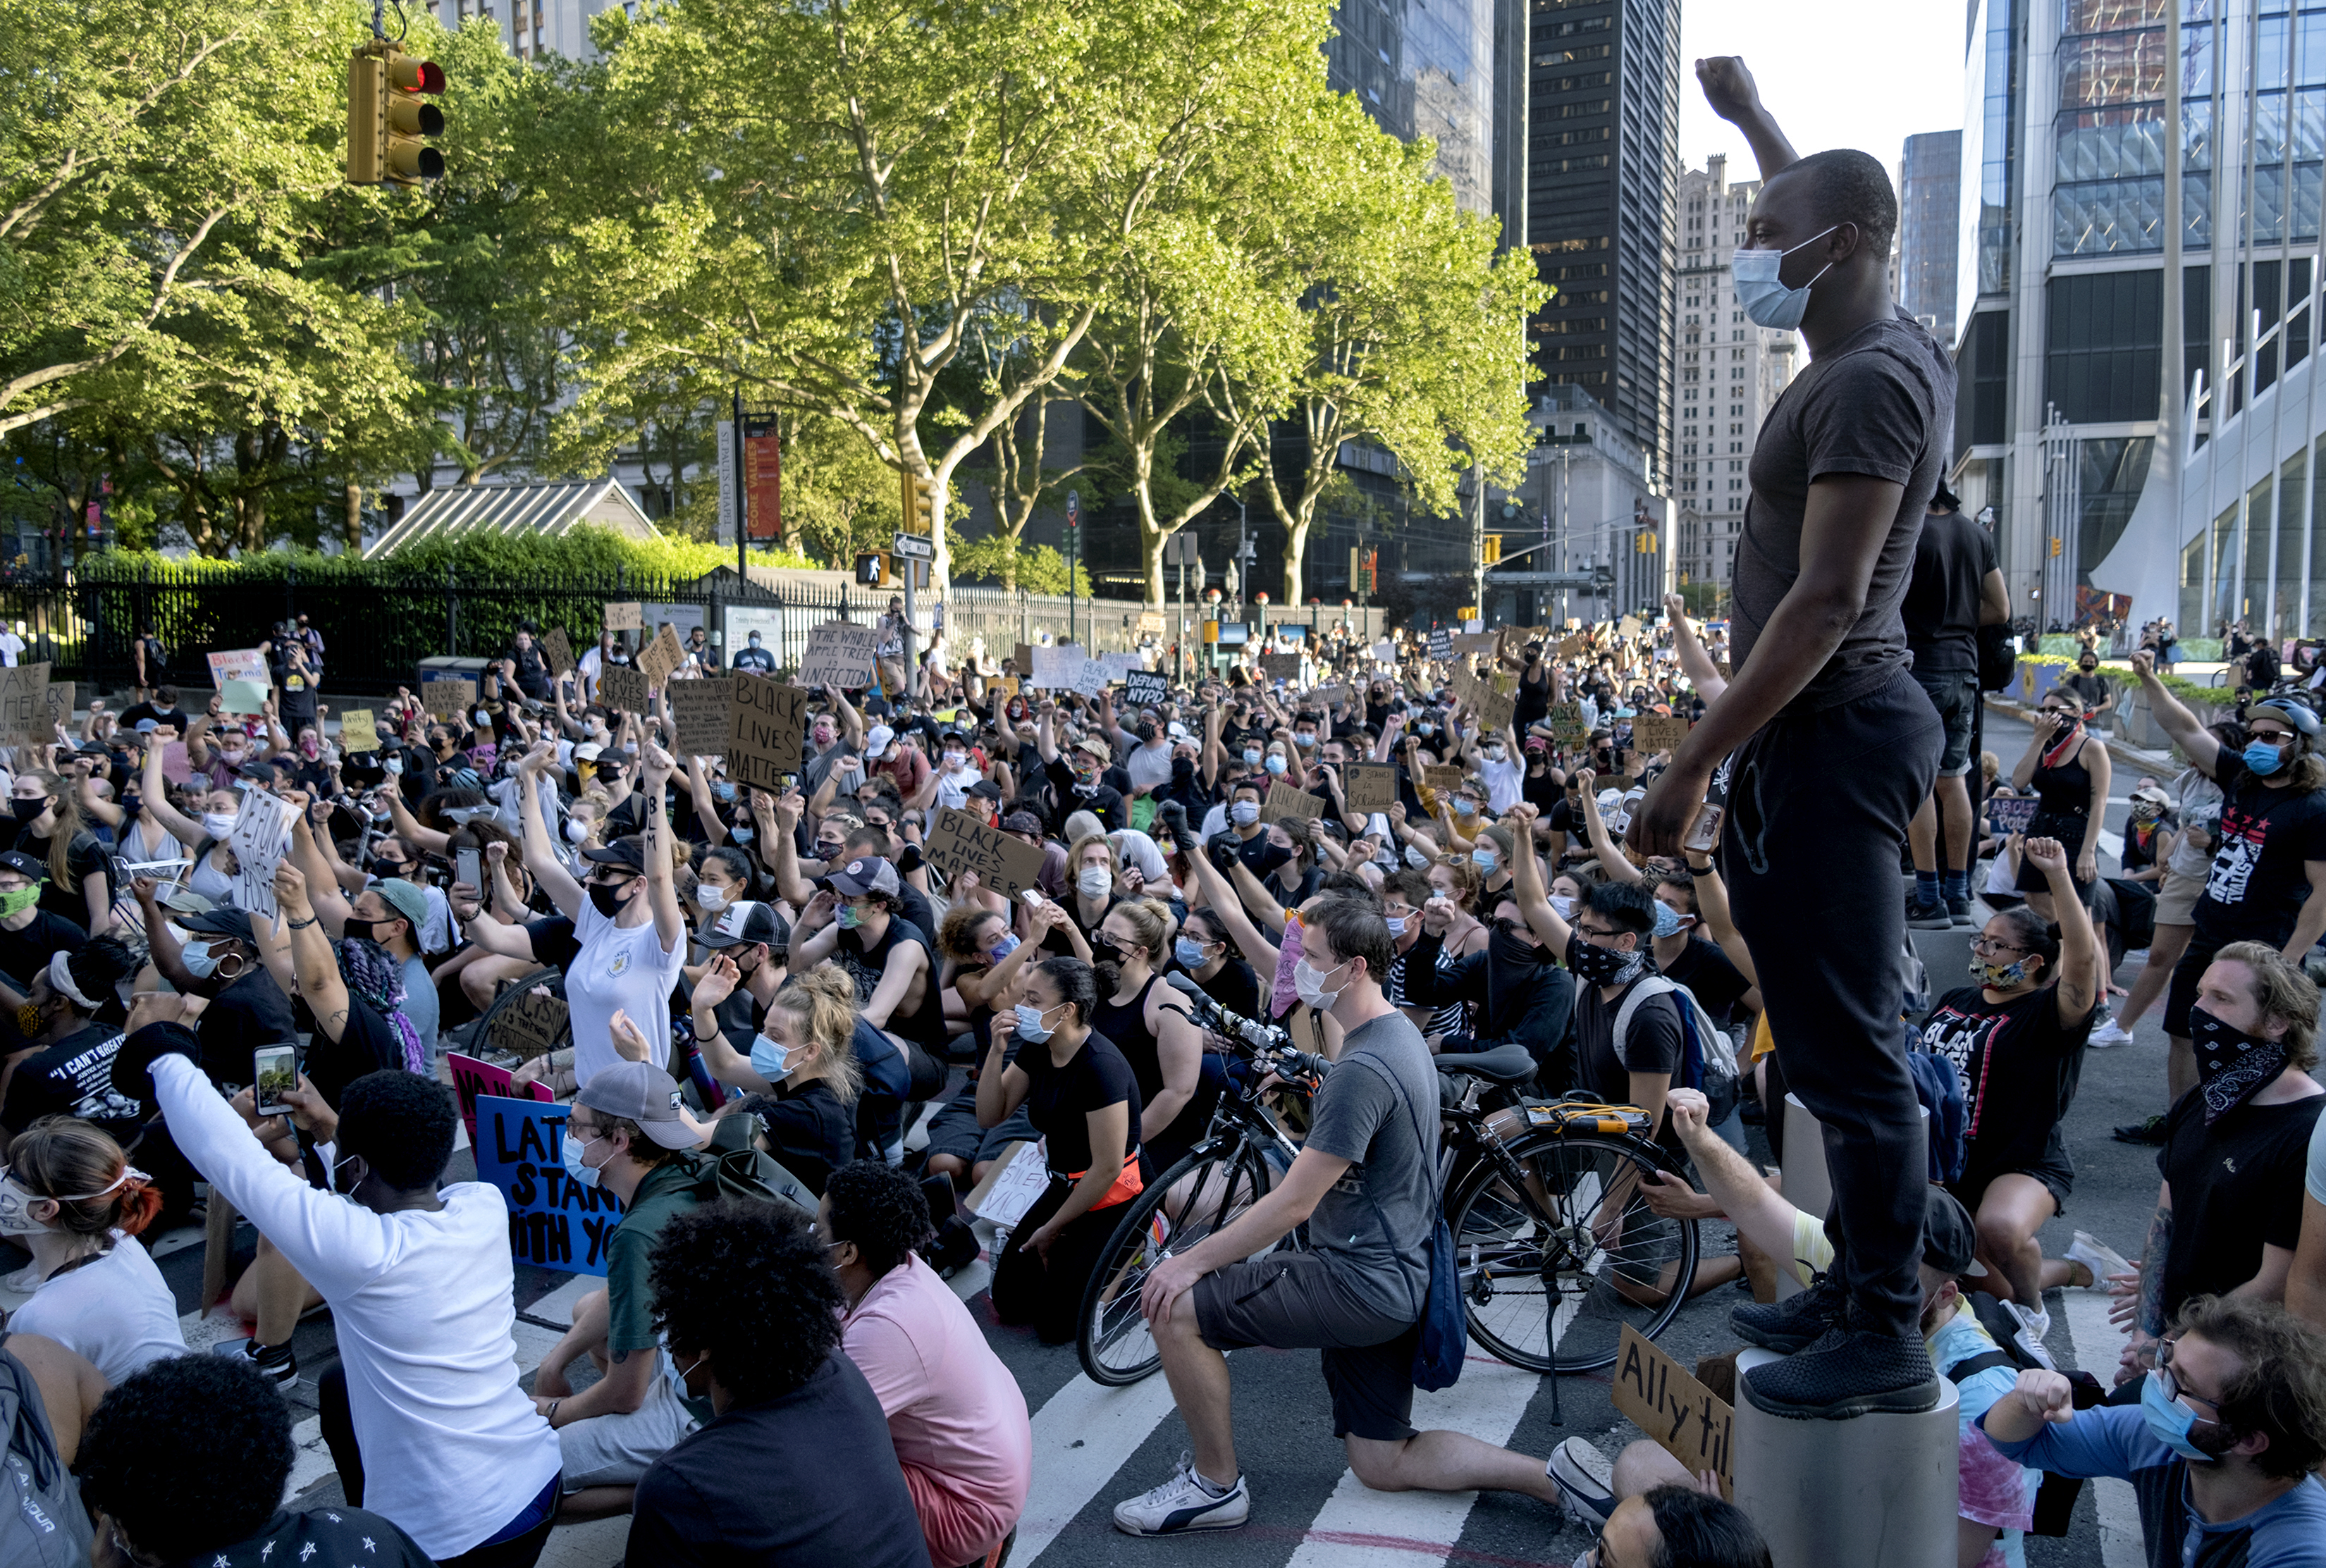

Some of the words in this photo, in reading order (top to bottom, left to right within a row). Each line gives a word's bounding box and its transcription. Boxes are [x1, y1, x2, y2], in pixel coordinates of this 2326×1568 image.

[721, 448, 731, 481] PAUL'S
[748, 441, 758, 489] VALUES
[722, 483, 732, 528] CHAPEL
[749, 493, 759, 529] CORE
[901, 541, 911, 551] ONE
[916, 544, 929, 554] WAY
[735, 617, 749, 625] Trinity
[814, 629, 835, 643] THE
[841, 630, 878, 648] WHOLE
[211, 653, 248, 667] Black
[807, 645, 838, 657] APPLE
[842, 646, 872, 661] TREE
[1044, 648, 1074, 660] BLACK
[605, 666, 643, 688] BLACK
[804, 667, 867, 686] INFECTED
[1083, 660, 1109, 679] BLACK
[3, 667, 39, 693] ARE
[427, 684, 465, 693] BLACK
[671, 681, 689, 691] THIS
[691, 681, 698, 691] IS
[1081, 674, 1100, 686] LIVES
[1128, 672, 1167, 691] DEFUND
[1458, 665, 1510, 712] BREONNA
[428, 693, 465, 701] LIVES
[604, 681, 644, 700] LIVES
[1074, 681, 1099, 699] MATT
[1127, 688, 1165, 704] NYPD
[605, 693, 646, 713] MATTER
[736, 676, 803, 731] BLACK
[343, 713, 369, 728] Unity
[1549, 704, 1580, 722] BLACK
[1637, 717, 1668, 727] BLACK
[737, 713, 797, 761] LIVES
[1553, 724, 1582, 736] LIVES
[1649, 727, 1678, 736] LIVES
[347, 742, 374, 752] Power
[1641, 739, 1681, 751] MATTER
[726, 747, 787, 788] MATTE
[1365, 768, 1390, 780] STAND
[1362, 781, 1372, 789] in
[1271, 783, 1296, 810] BLACK
[1298, 793, 1319, 817] LIVES
[234, 787, 292, 859] DEFUND
[646, 796, 658, 852] BLM
[940, 811, 1005, 862] BLACK
[952, 840, 1002, 874] LIVES
[927, 847, 1019, 899] MATTER
[503, 1011, 514, 1024] IS
[517, 1017, 534, 1032] THE
[1924, 1021, 1983, 1052] BLACK
[65, 1049, 99, 1075] CAN'T
[77, 1065, 97, 1080] JUSTICE
[494, 1112, 565, 1163] LAT
[1001, 1165, 1049, 1190] SILEN
[511, 1162, 626, 1215] STAN
[1621, 1340, 1690, 1444] Ally
